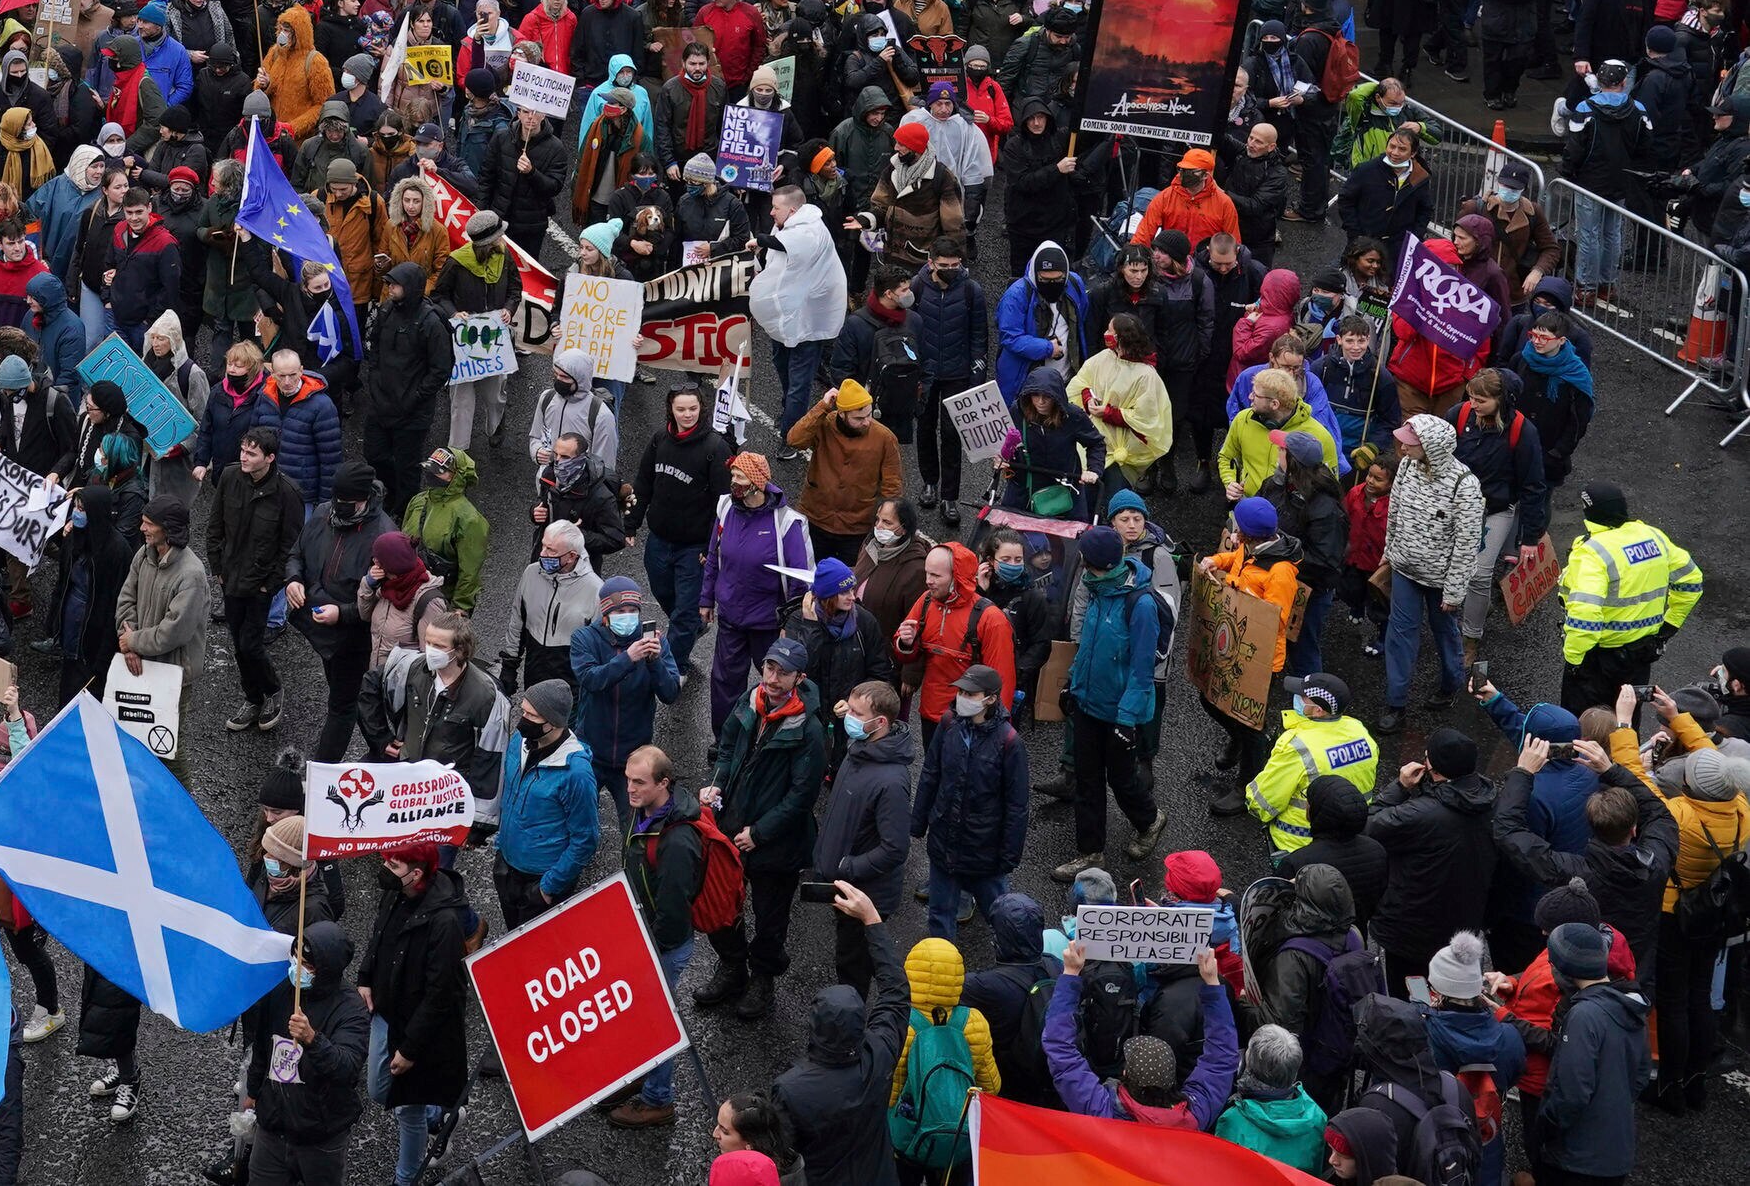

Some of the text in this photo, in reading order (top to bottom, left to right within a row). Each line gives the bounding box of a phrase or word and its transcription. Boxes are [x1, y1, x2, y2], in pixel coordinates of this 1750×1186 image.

[404, 58, 451, 81] NO!
[515, 70, 572, 95] BAD POLITICIANS
[513, 84, 569, 109] RUIN THE PLANET!
[1111, 93, 1193, 117] Apocalypse Now
[725, 105, 750, 120] NO
[722, 128, 748, 143] OIL
[724, 117, 761, 133] NEW
[1082, 120, 1211, 143] COMING SOON SOMEWHERE NEAR YOU?
[720, 141, 766, 157] FIELD
[577, 279, 610, 302] NO
[1415, 258, 1491, 324] ROSA
[569, 301, 628, 327] MORE
[566, 321, 615, 341] BLAH
[954, 389, 989, 411] DO IT
[954, 400, 1001, 425] FOR MY
[960, 415, 1011, 451] FUTURE
[1625, 540, 1661, 563] POLICE
[1512, 559, 1561, 617] CAMBO
[119, 693, 150, 703] extinction
[1232, 691, 1265, 721] NOW
[123, 710, 154, 720] rebellion
[1328, 740, 1371, 767] POLICE
[391, 773, 461, 797] GRASSROOTS
[389, 786, 466, 810] GLOBAL JUSTICE
[386, 801, 465, 824] ALLIANCE
[338, 843, 353, 851] NO
[1082, 910, 1211, 928] CORPORATE
[1078, 927, 1212, 947] RESPONSIBILITY
[525, 946, 601, 1013] ROAD
[526, 979, 634, 1064] CLOSED
